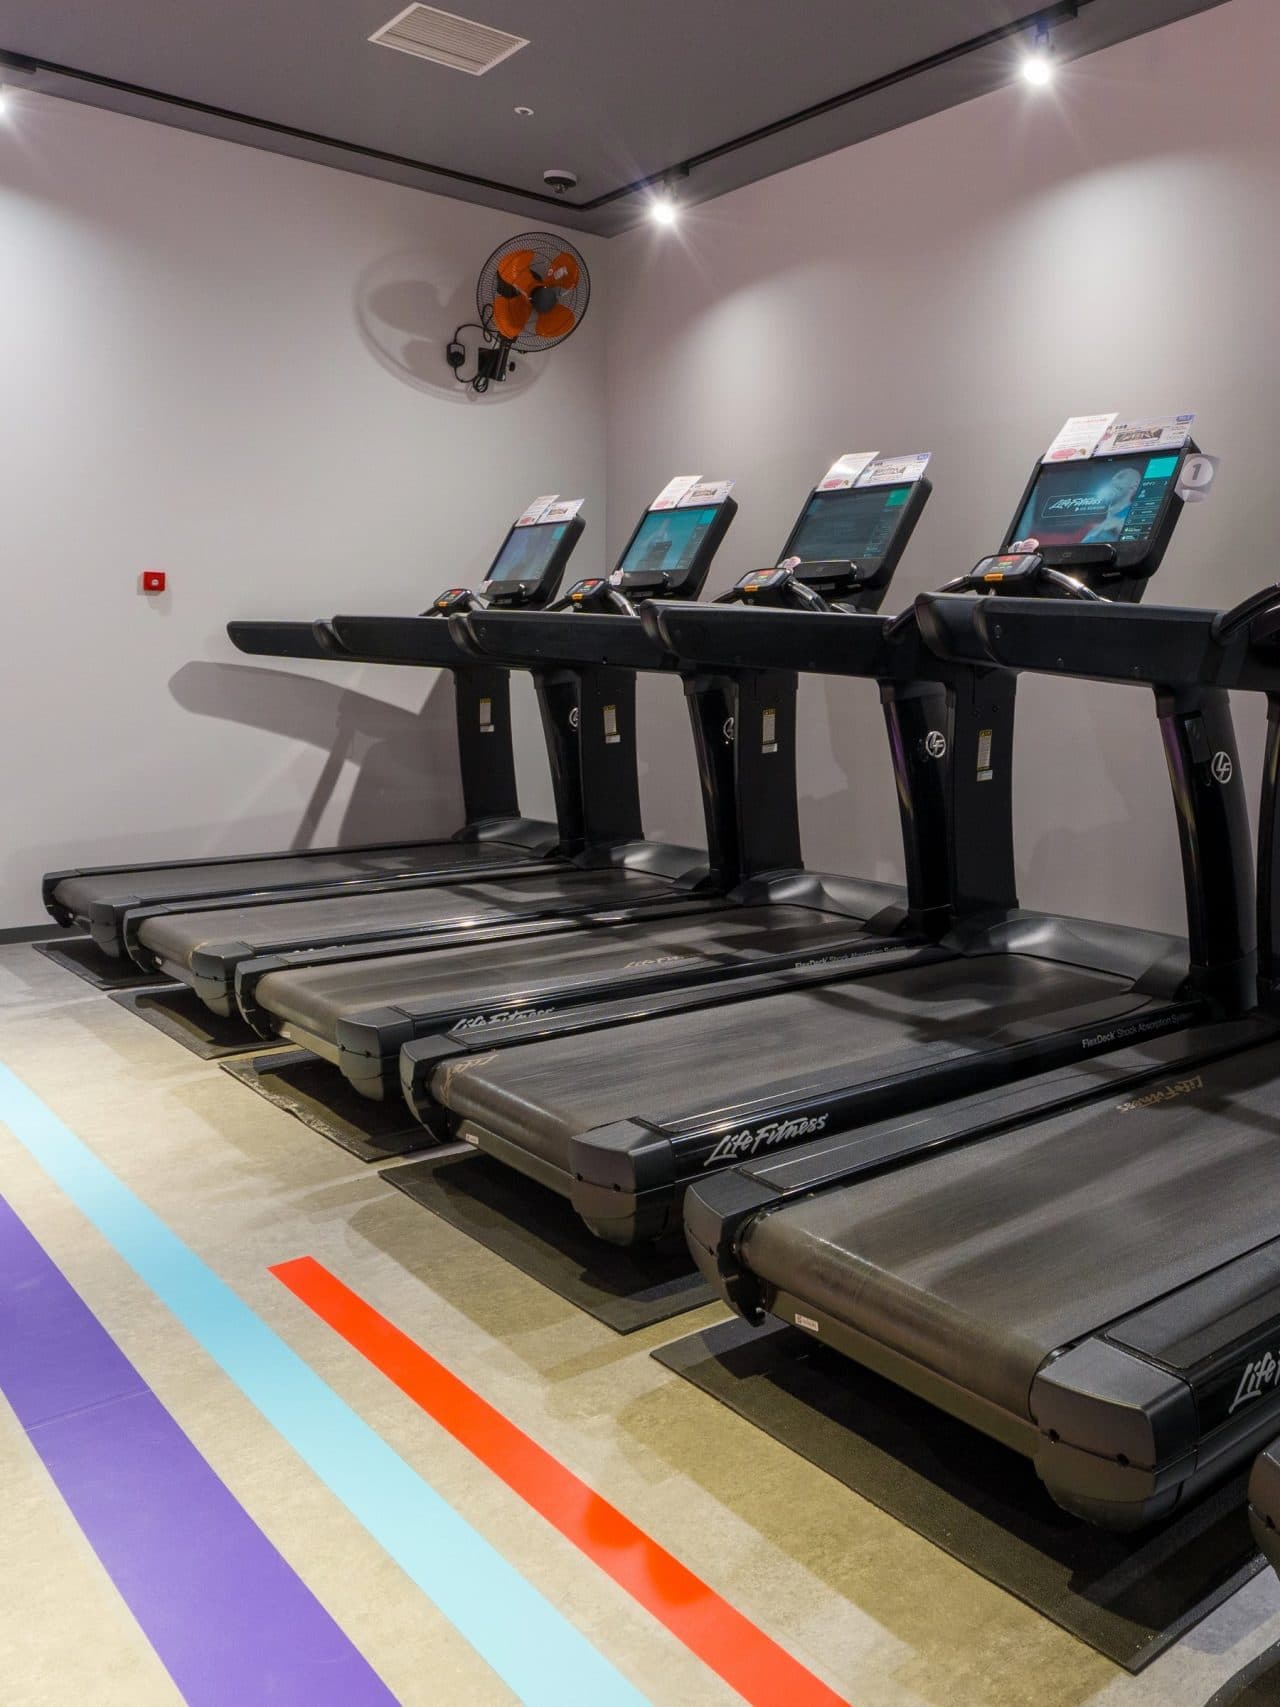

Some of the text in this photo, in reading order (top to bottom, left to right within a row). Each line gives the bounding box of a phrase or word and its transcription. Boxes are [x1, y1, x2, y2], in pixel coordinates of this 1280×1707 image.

[1192, 463, 1202, 480] 1
[703, 1113, 828, 1166] Life Fitness
[1228, 1351, 1276, 1414] Life
